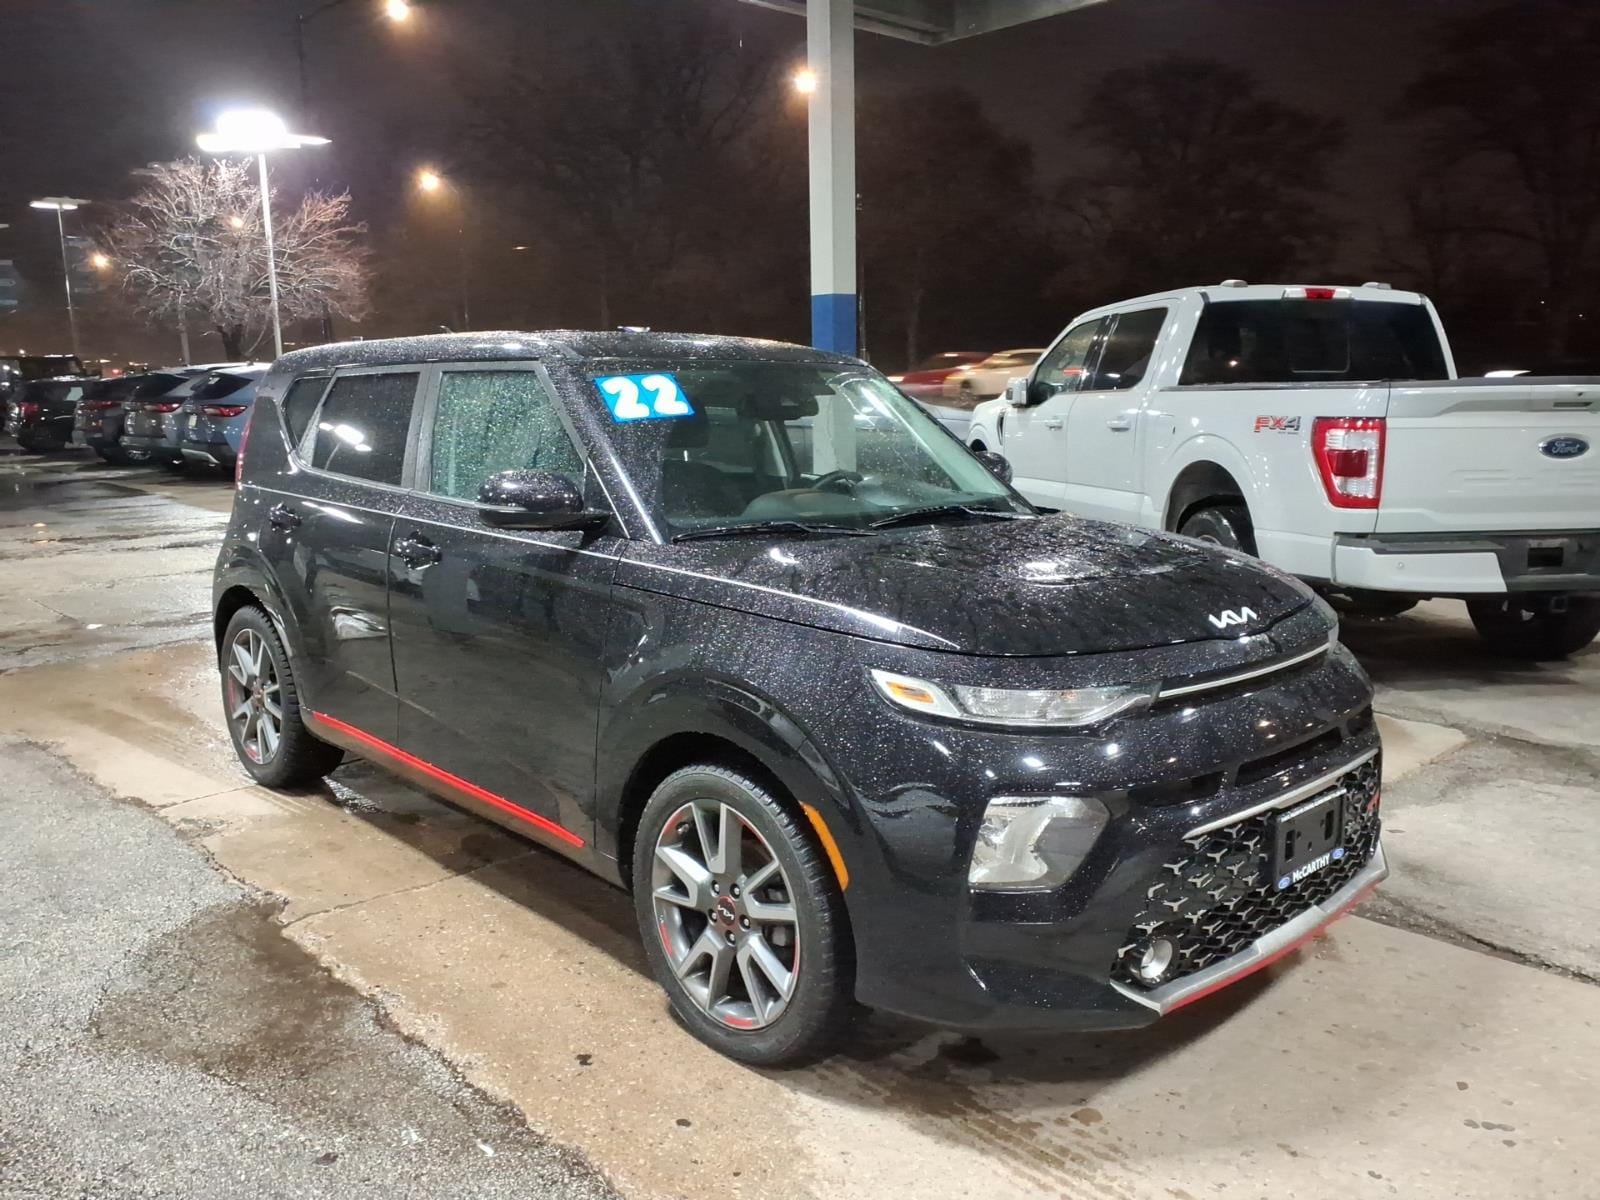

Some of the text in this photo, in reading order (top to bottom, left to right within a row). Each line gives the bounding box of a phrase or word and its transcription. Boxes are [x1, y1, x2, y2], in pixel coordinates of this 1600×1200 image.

[601, 374, 689, 418] 22
[1253, 415, 1301, 432] FX4
[1208, 606, 1258, 629] KIA
[1292, 853, 1331, 883] McCARTHY
